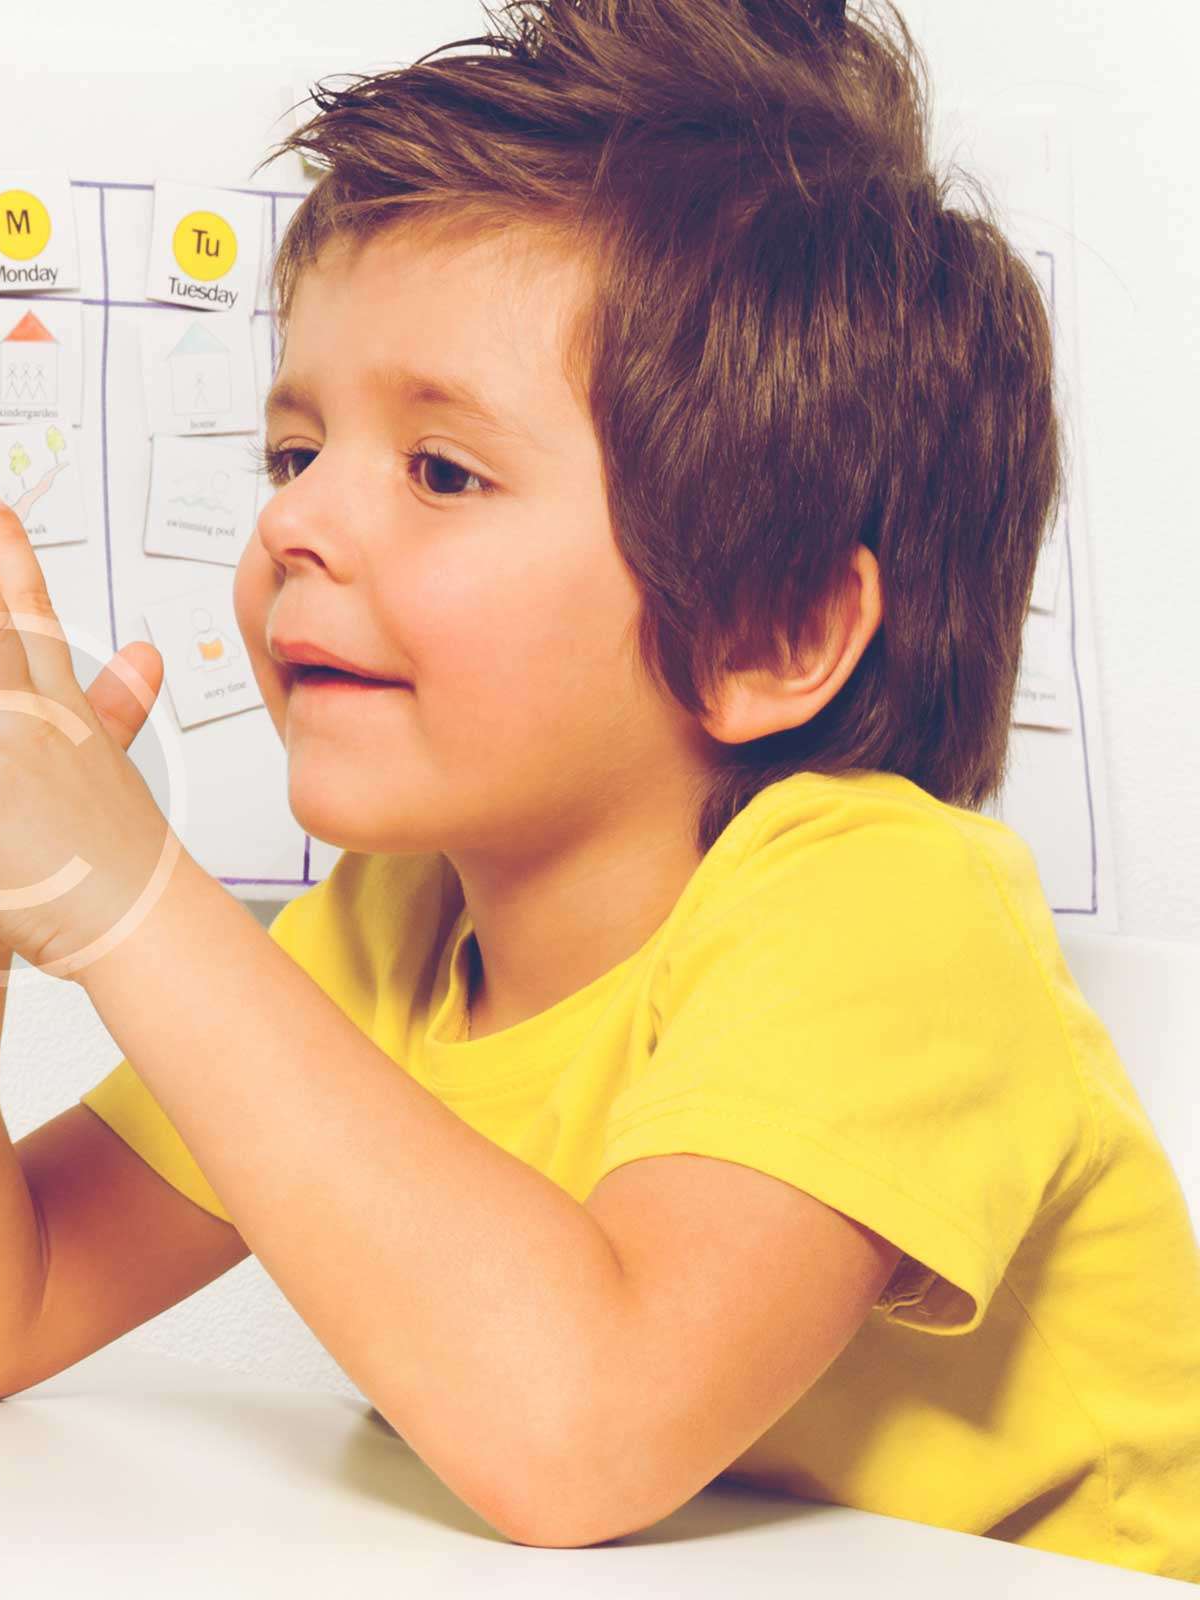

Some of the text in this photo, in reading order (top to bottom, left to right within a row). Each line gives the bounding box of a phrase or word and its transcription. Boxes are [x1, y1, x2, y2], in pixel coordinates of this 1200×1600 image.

[5, 208, 31, 235] M
[191, 227, 221, 257] Tu
[168, 276, 239, 309] Tuesday
[214, 525, 237, 539] pool
